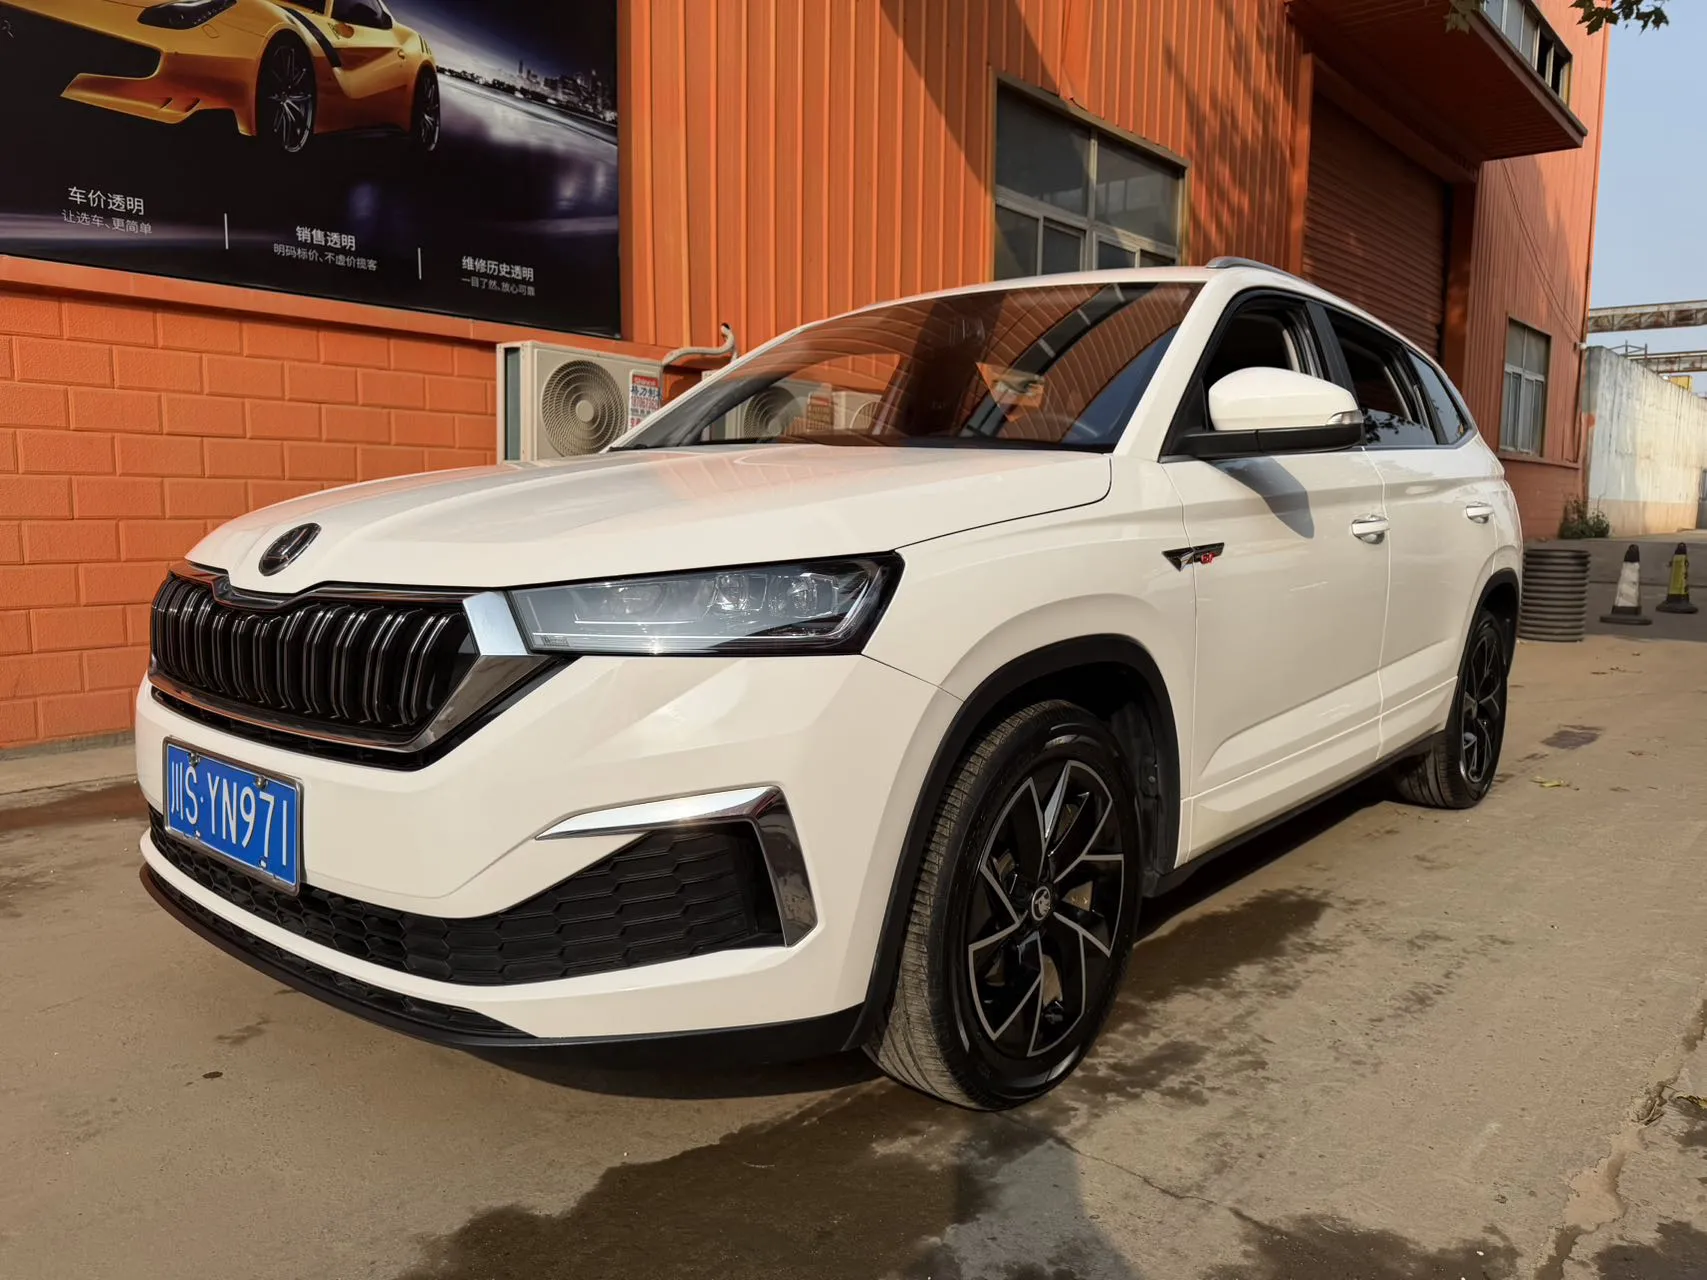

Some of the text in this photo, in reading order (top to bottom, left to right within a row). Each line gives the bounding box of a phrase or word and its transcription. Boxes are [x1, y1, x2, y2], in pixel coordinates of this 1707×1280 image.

[67, 186, 145, 216] 车价透明
[61, 209, 153, 236] 让选车、更简单
[295, 225, 356, 252] 销售透明
[461, 255, 535, 282] 维修历史透明
